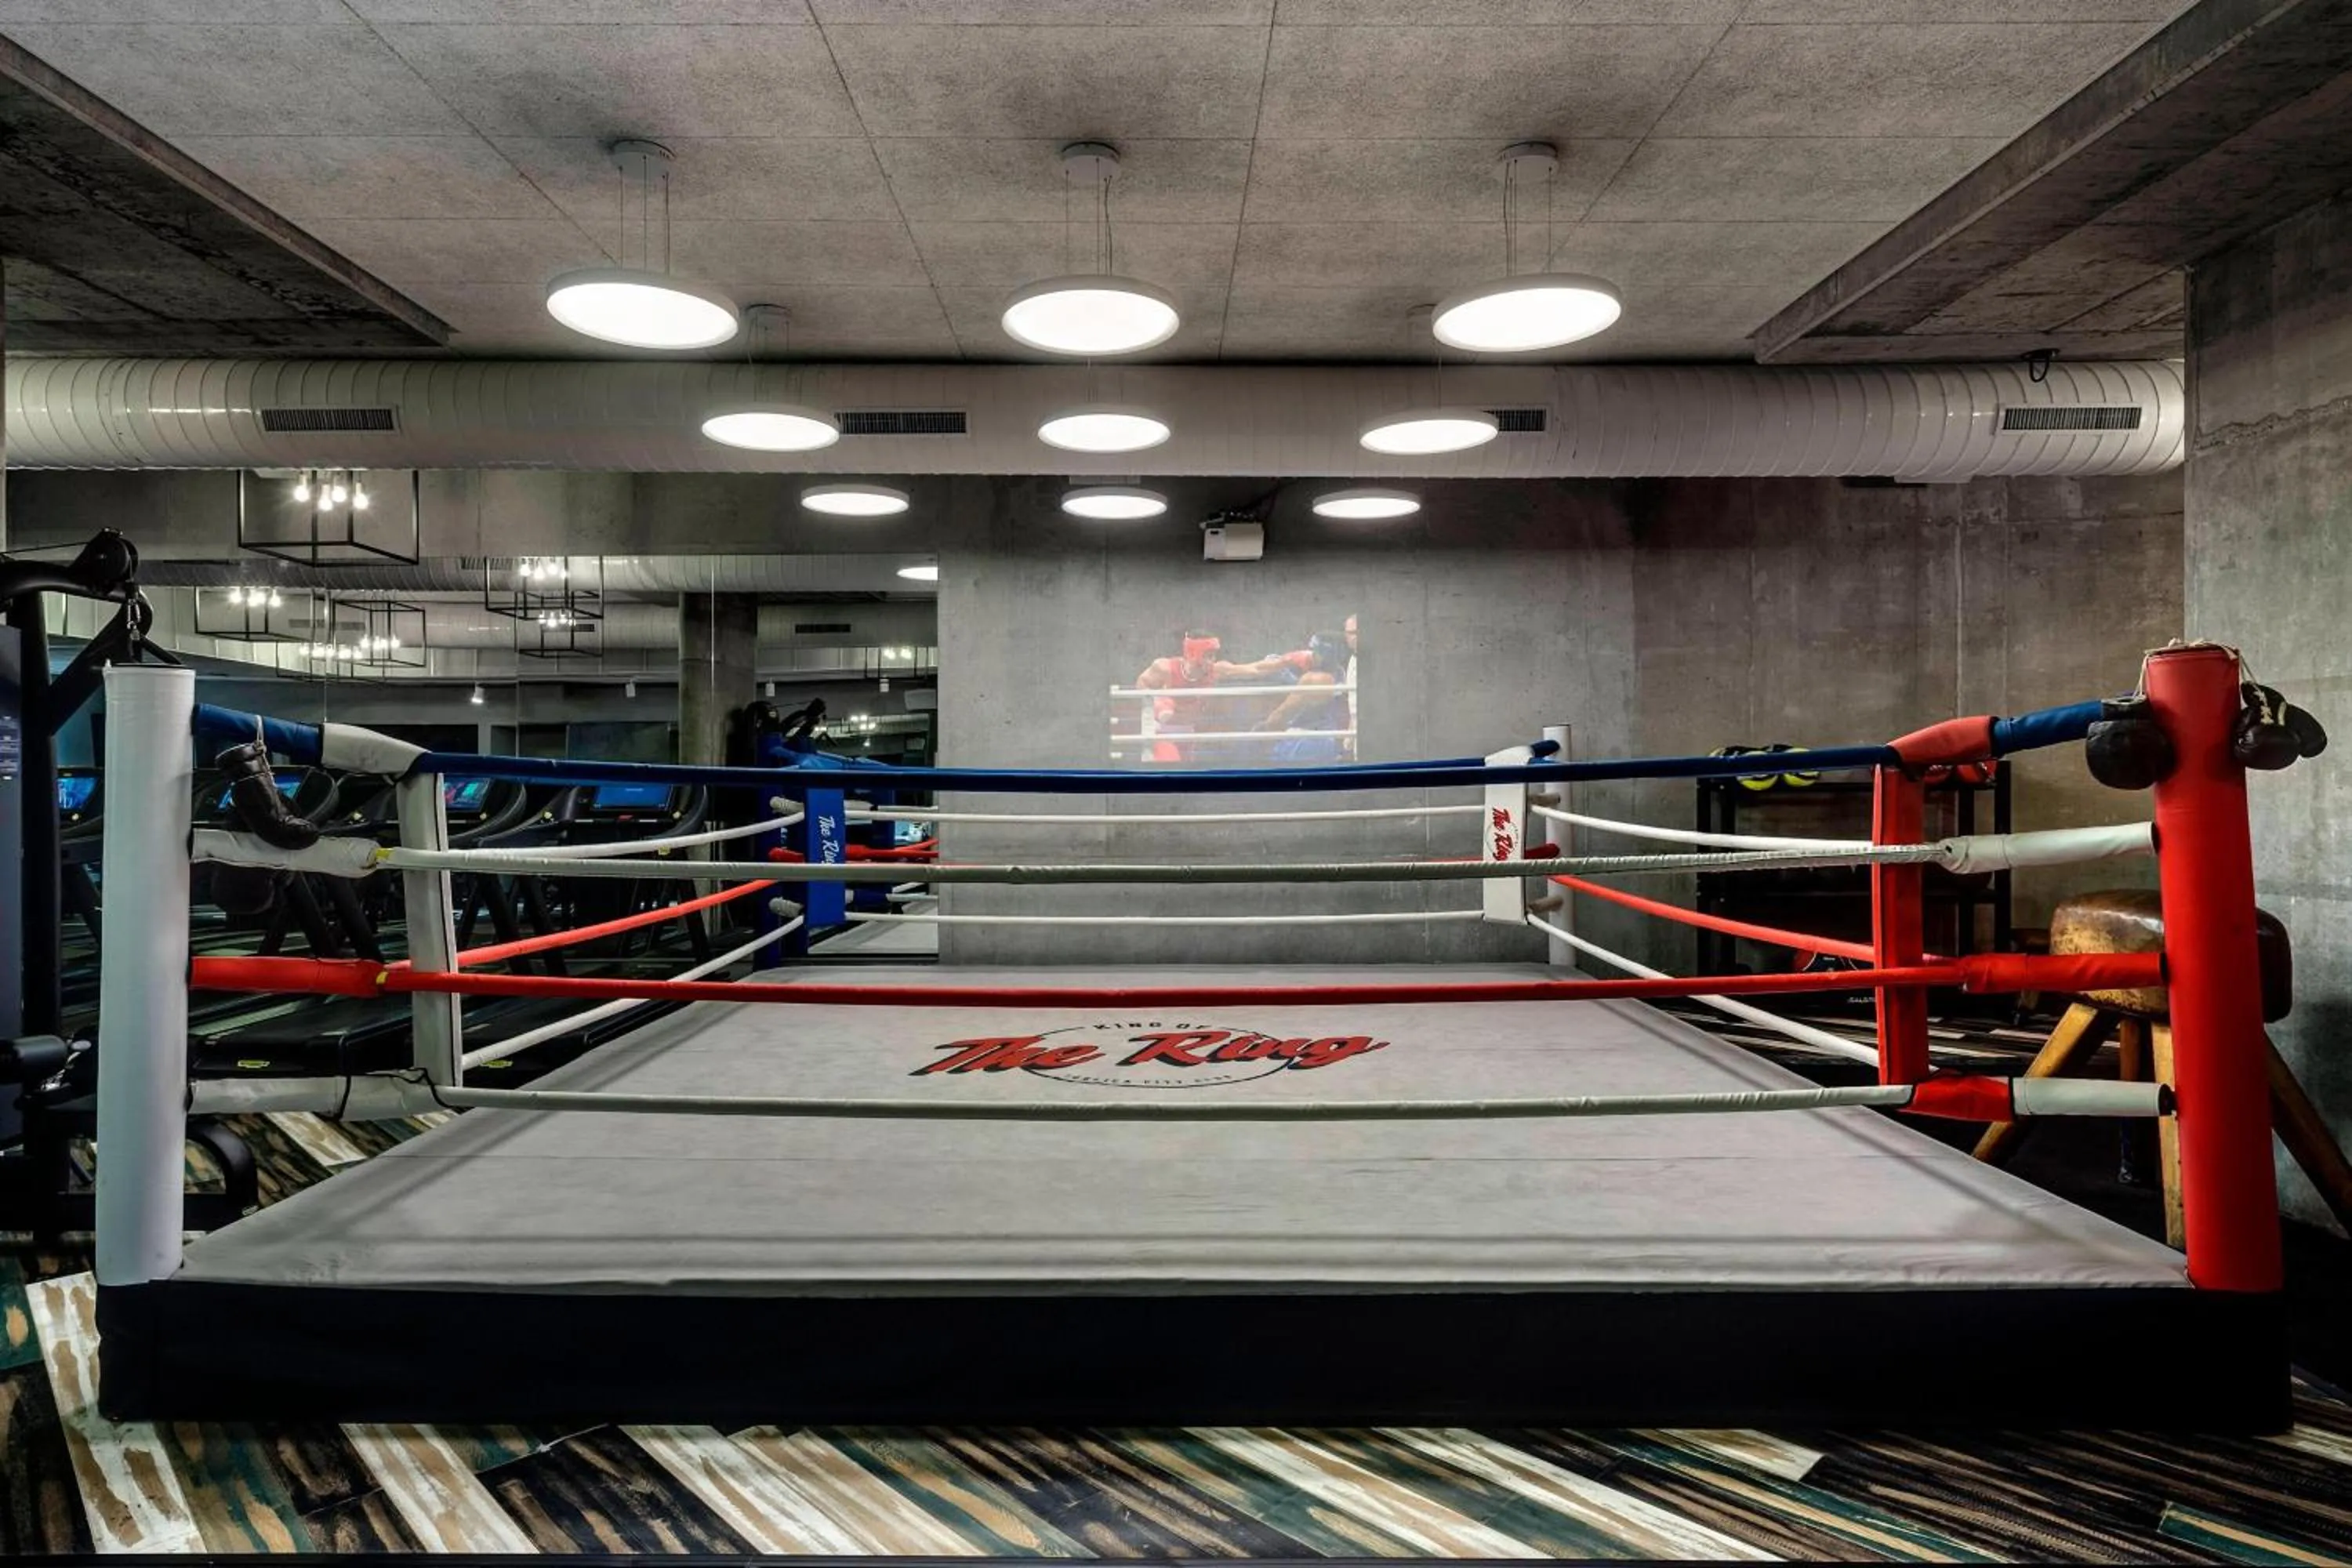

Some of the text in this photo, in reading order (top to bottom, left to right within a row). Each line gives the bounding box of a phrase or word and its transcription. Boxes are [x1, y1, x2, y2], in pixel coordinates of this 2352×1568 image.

[818, 815, 840, 864] The Rin
[1493, 808, 1511, 831] The
[907, 1030, 1391, 1076] The Ring
